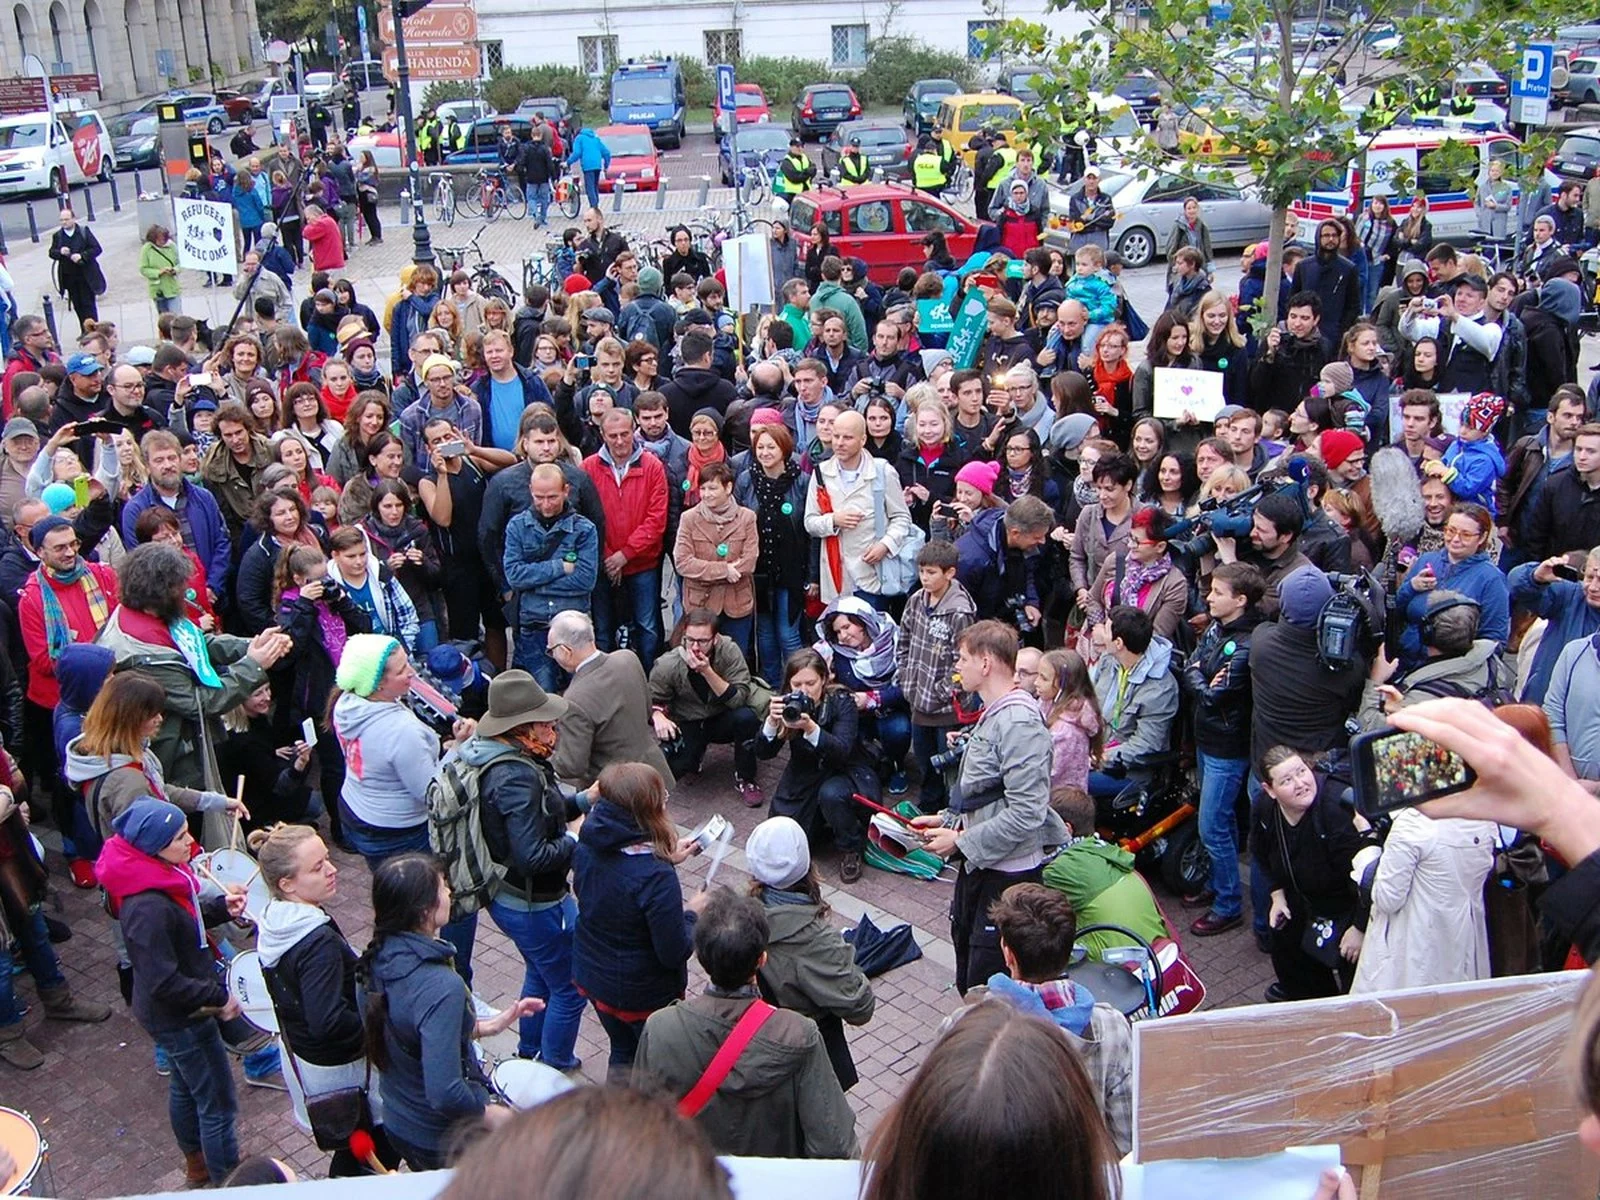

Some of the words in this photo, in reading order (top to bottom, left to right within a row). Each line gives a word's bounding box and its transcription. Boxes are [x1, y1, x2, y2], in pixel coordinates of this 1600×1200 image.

[402, 14, 434, 25] Hotel
[403, 26, 452, 37] Harenda
[407, 56, 471, 69] HARENDA
[1520, 50, 1544, 91] P
[721, 70, 732, 104] P
[181, 204, 226, 227] REFUGEES
[184, 239, 228, 262] WELCOME
